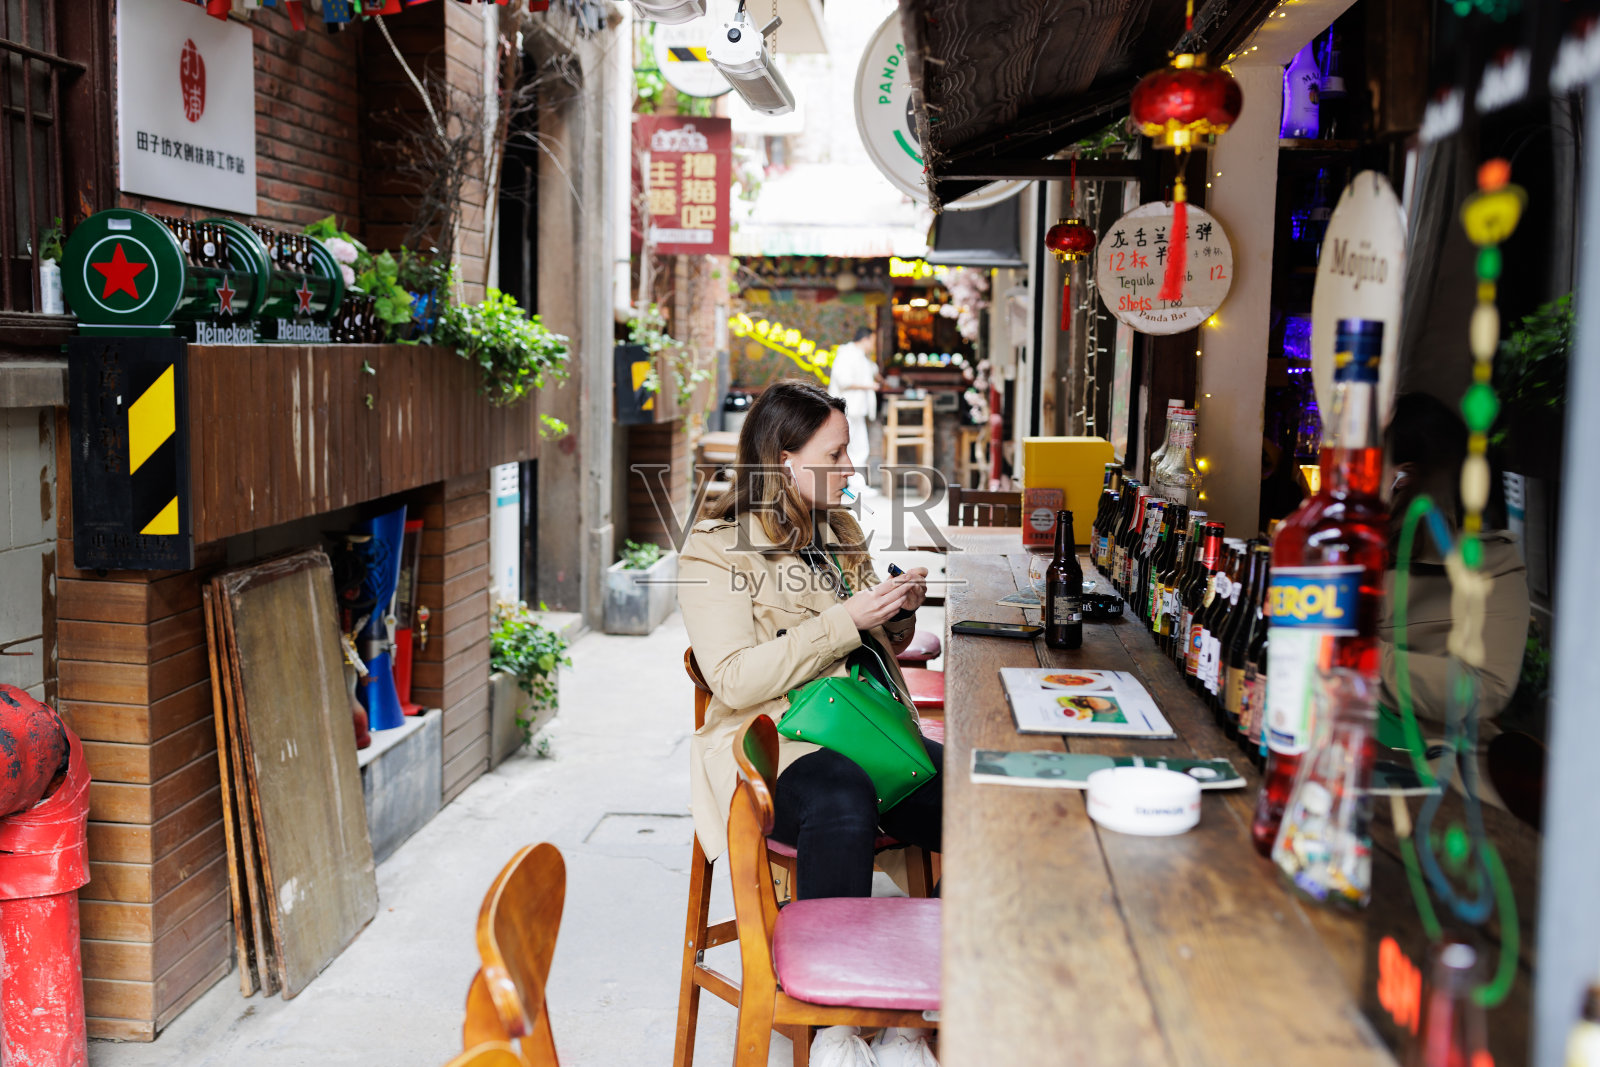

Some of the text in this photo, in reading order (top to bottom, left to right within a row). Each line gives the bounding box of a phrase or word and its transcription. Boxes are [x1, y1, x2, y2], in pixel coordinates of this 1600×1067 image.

[136, 130, 246, 174] 田子坊文创扶持工作站
[1209, 264, 1227, 280] 12
[1329, 238, 1389, 292] Mojito
[1116, 272, 1155, 295] Tequila
[1118, 294, 1152, 311] Shots
[1139, 310, 1188, 322] Panda Bar
[195, 321, 257, 343] Heineken
[277, 318, 331, 342] Heineken
